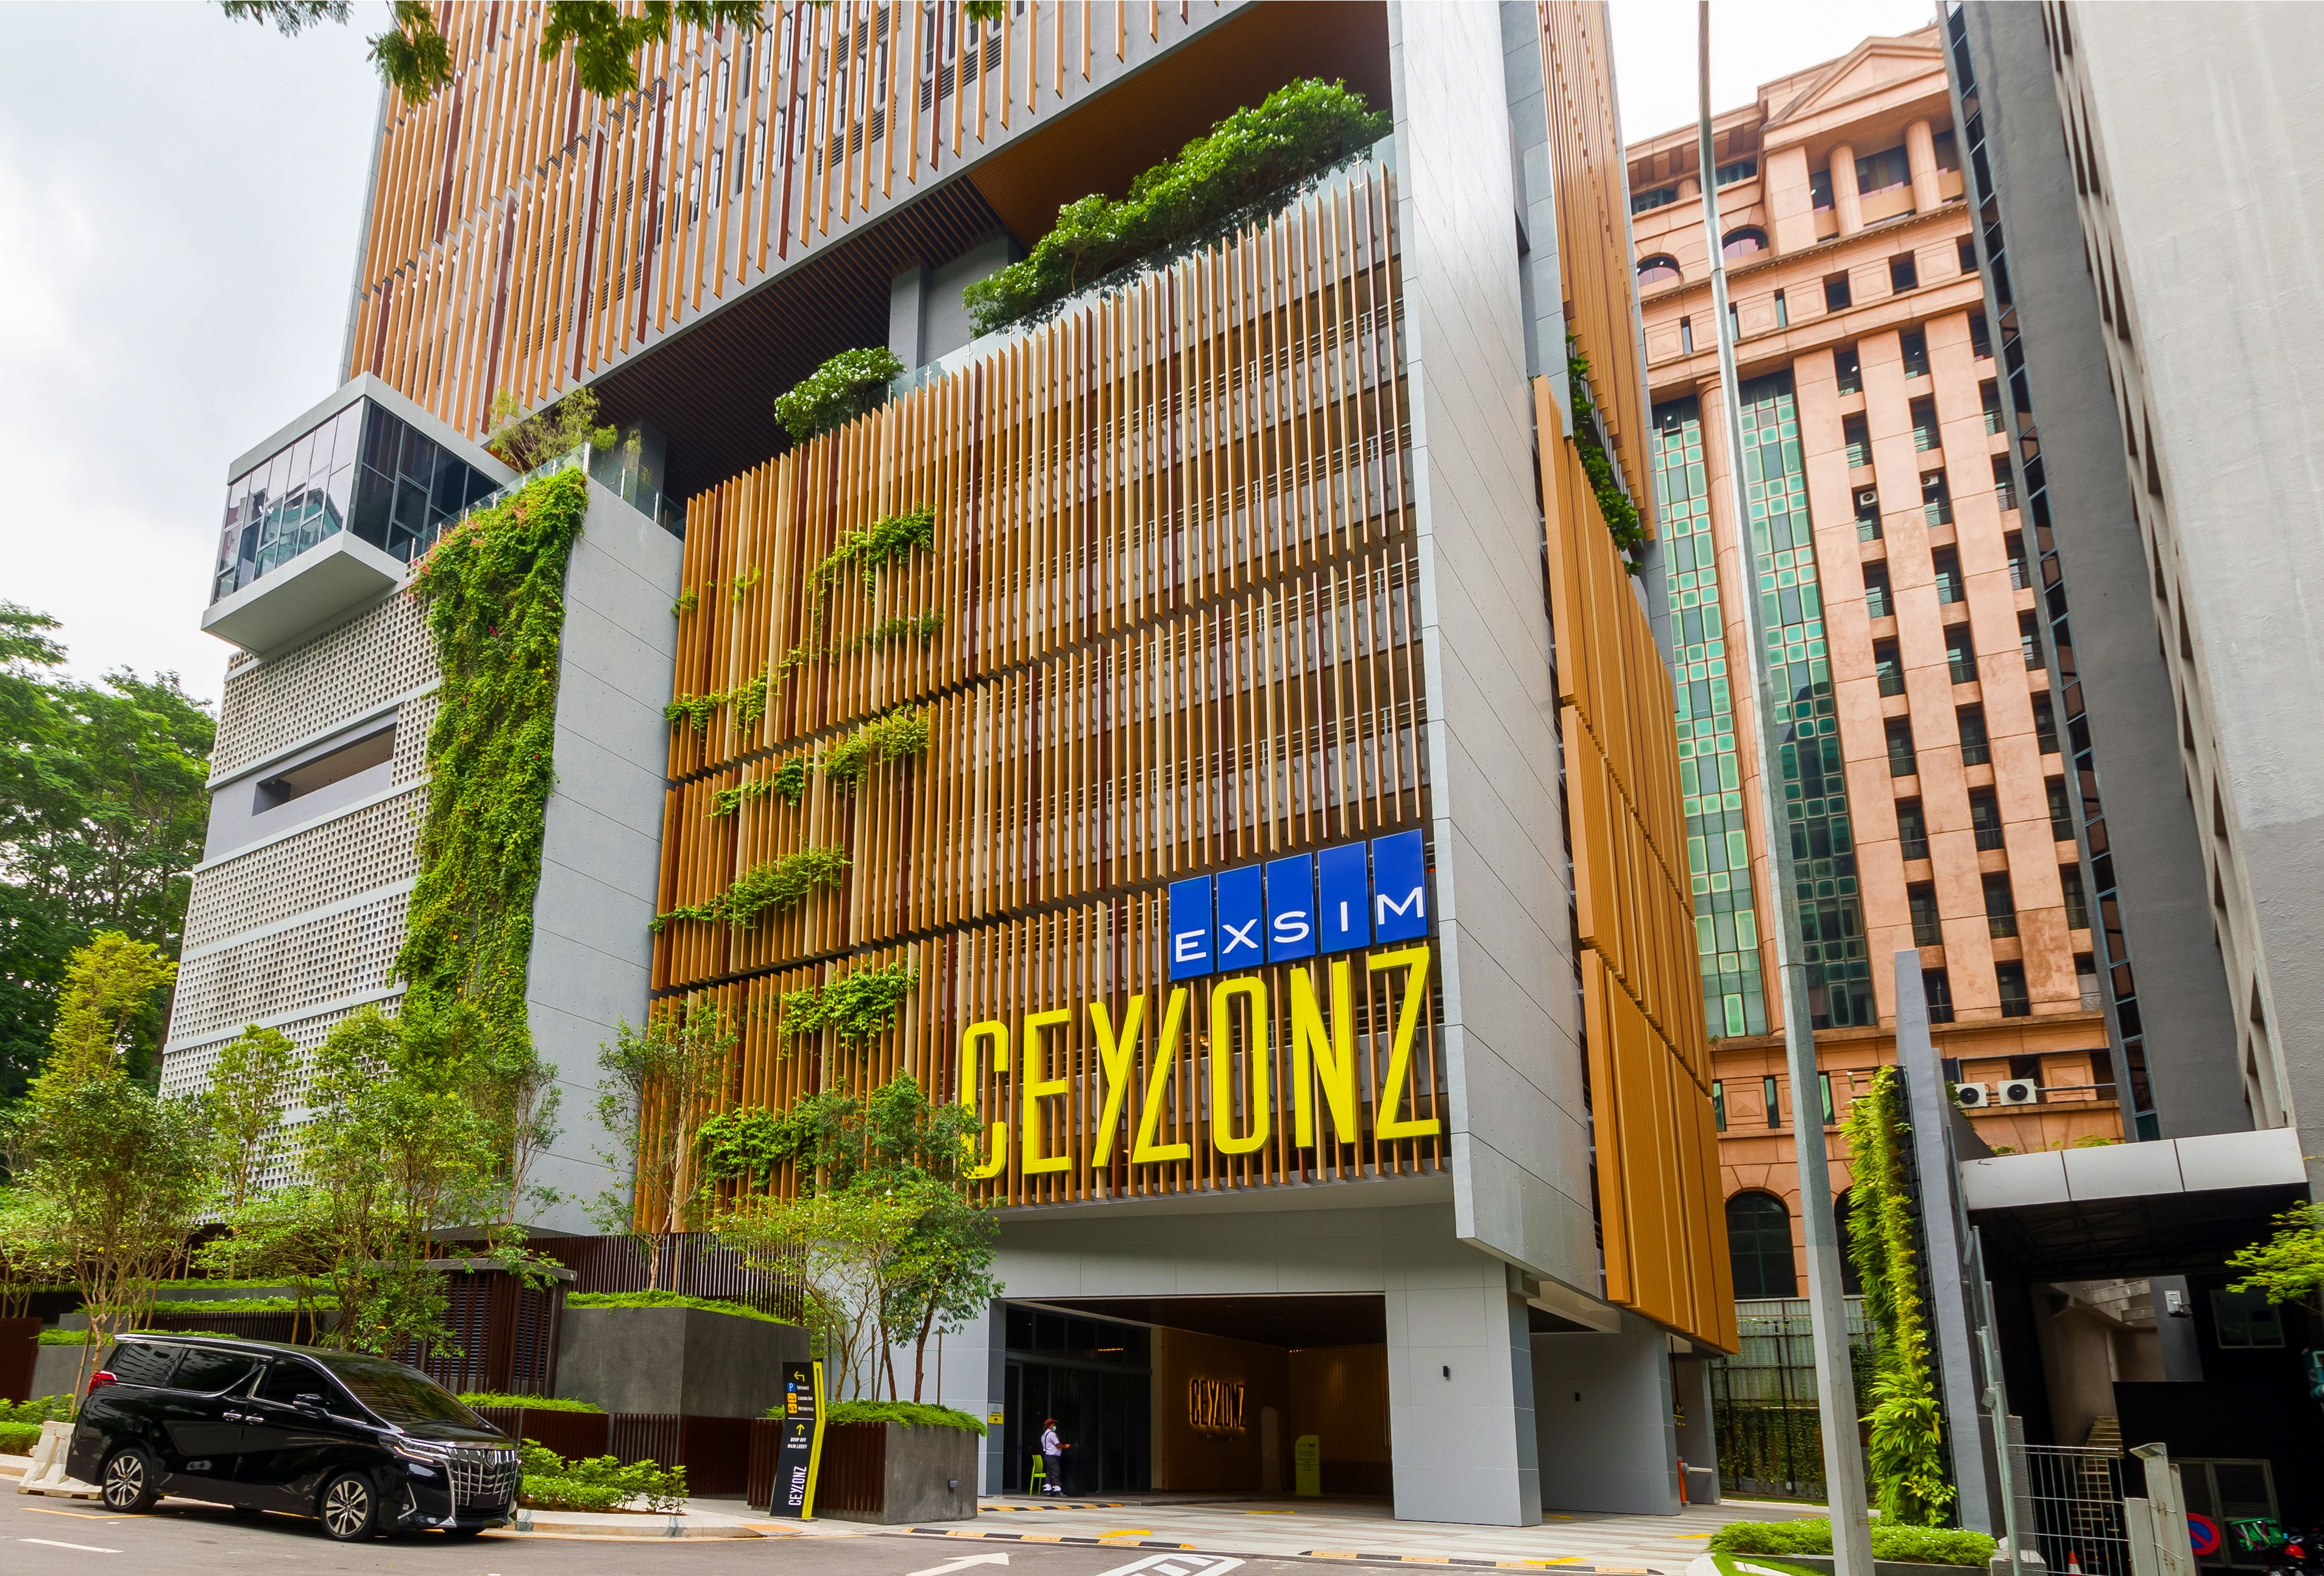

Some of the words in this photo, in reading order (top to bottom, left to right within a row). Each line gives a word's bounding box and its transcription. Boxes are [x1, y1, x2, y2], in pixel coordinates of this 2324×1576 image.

[1175, 887, 1425, 963] EXSIM
[960, 946, 1441, 1179] CEYLONZ
[1189, 1378, 1247, 1428] CEYLONZ
[788, 1466, 807, 1506] CEYLONZ
